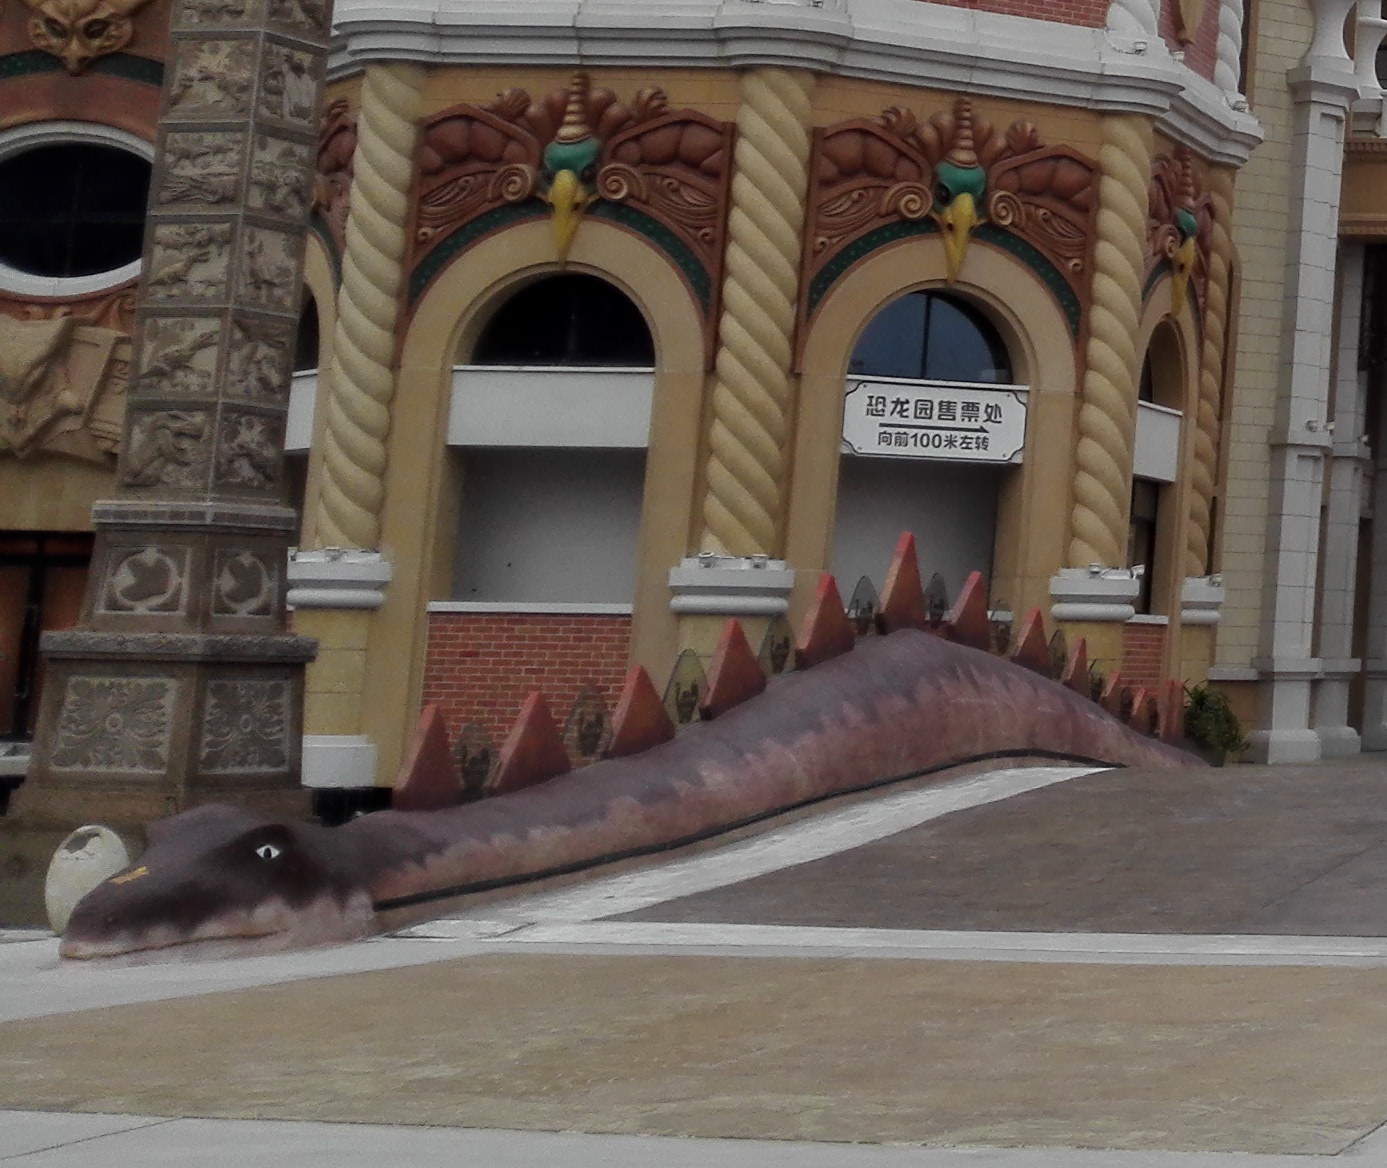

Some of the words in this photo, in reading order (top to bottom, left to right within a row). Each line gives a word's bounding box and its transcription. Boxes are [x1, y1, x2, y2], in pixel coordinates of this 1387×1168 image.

[866, 395, 1003, 424] 恐龙园售票处
[878, 430, 990, 451] 向前100米左转
